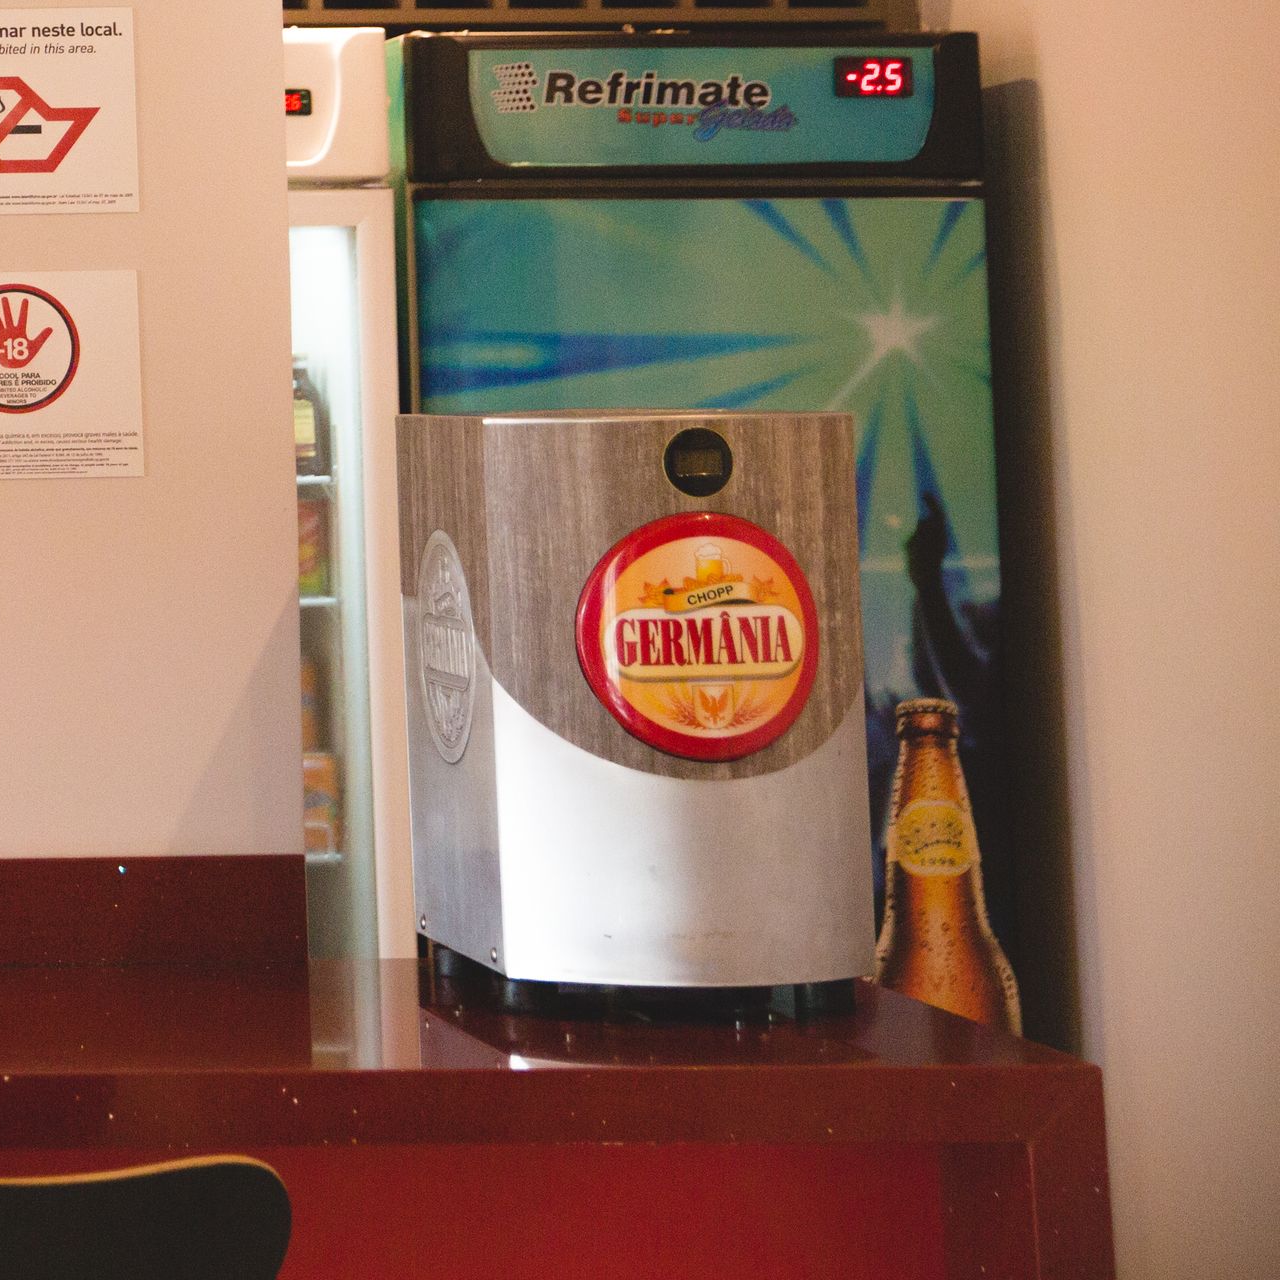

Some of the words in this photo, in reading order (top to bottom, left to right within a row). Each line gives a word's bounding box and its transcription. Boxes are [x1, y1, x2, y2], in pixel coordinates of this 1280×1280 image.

[31, 24, 76, 38] neste
[80, 21, 123, 37] local.
[29, 43, 41, 55] in
[43, 42, 65, 54] this
[67, 44, 97, 55] area.
[845, 62, 903, 91] -2.5
[544, 71, 771, 107] Refrimate
[21, 379, 57, 387] PROIBIDO
[686, 584, 735, 607] CHOPP
[614, 610, 794, 667] GERMÂNIA
